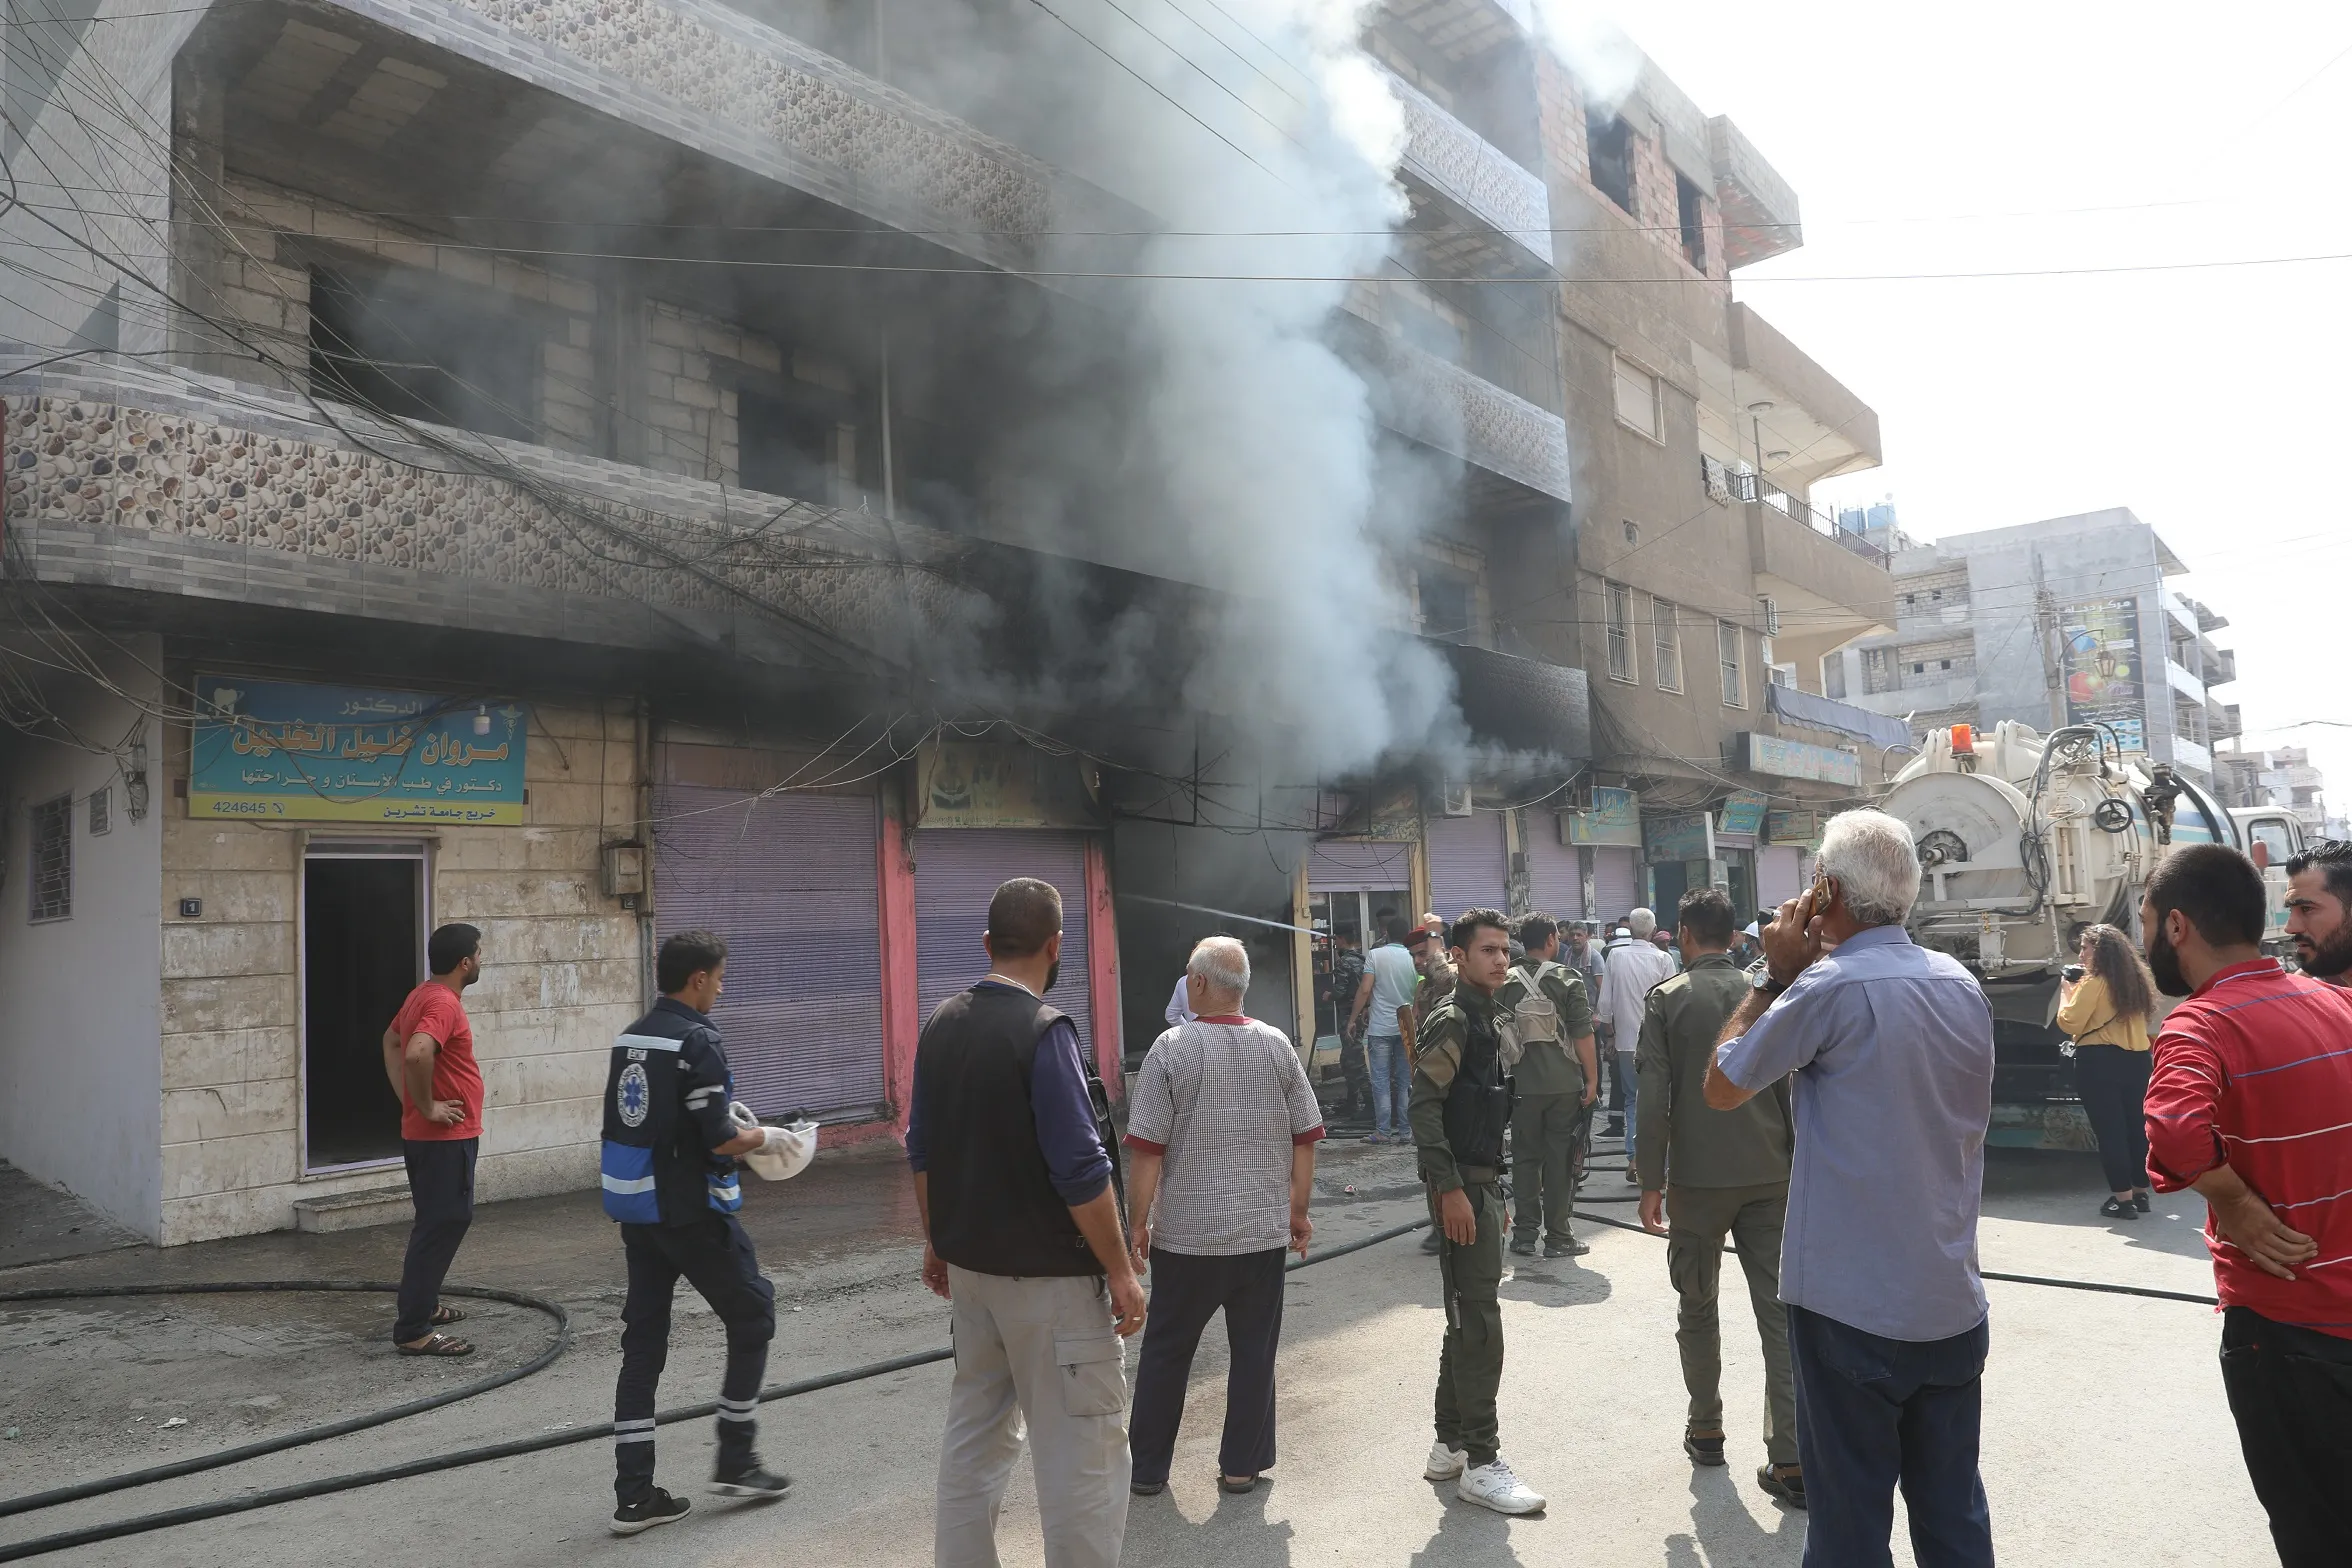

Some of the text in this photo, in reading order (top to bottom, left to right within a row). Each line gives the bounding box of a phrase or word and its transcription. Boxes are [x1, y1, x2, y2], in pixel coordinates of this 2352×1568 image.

[2099, 599, 2133, 613] مركز
[339, 696, 423, 716] الدكتور
[232, 718, 509, 767] مروان خليل الخليل
[241, 768, 502, 796] دكتور في طب الأسنان و جراحتها
[212, 801, 267, 815] 424645
[383, 804, 496, 821] خريج جامعة تشرين
[188, 902, 196, 912] 1
